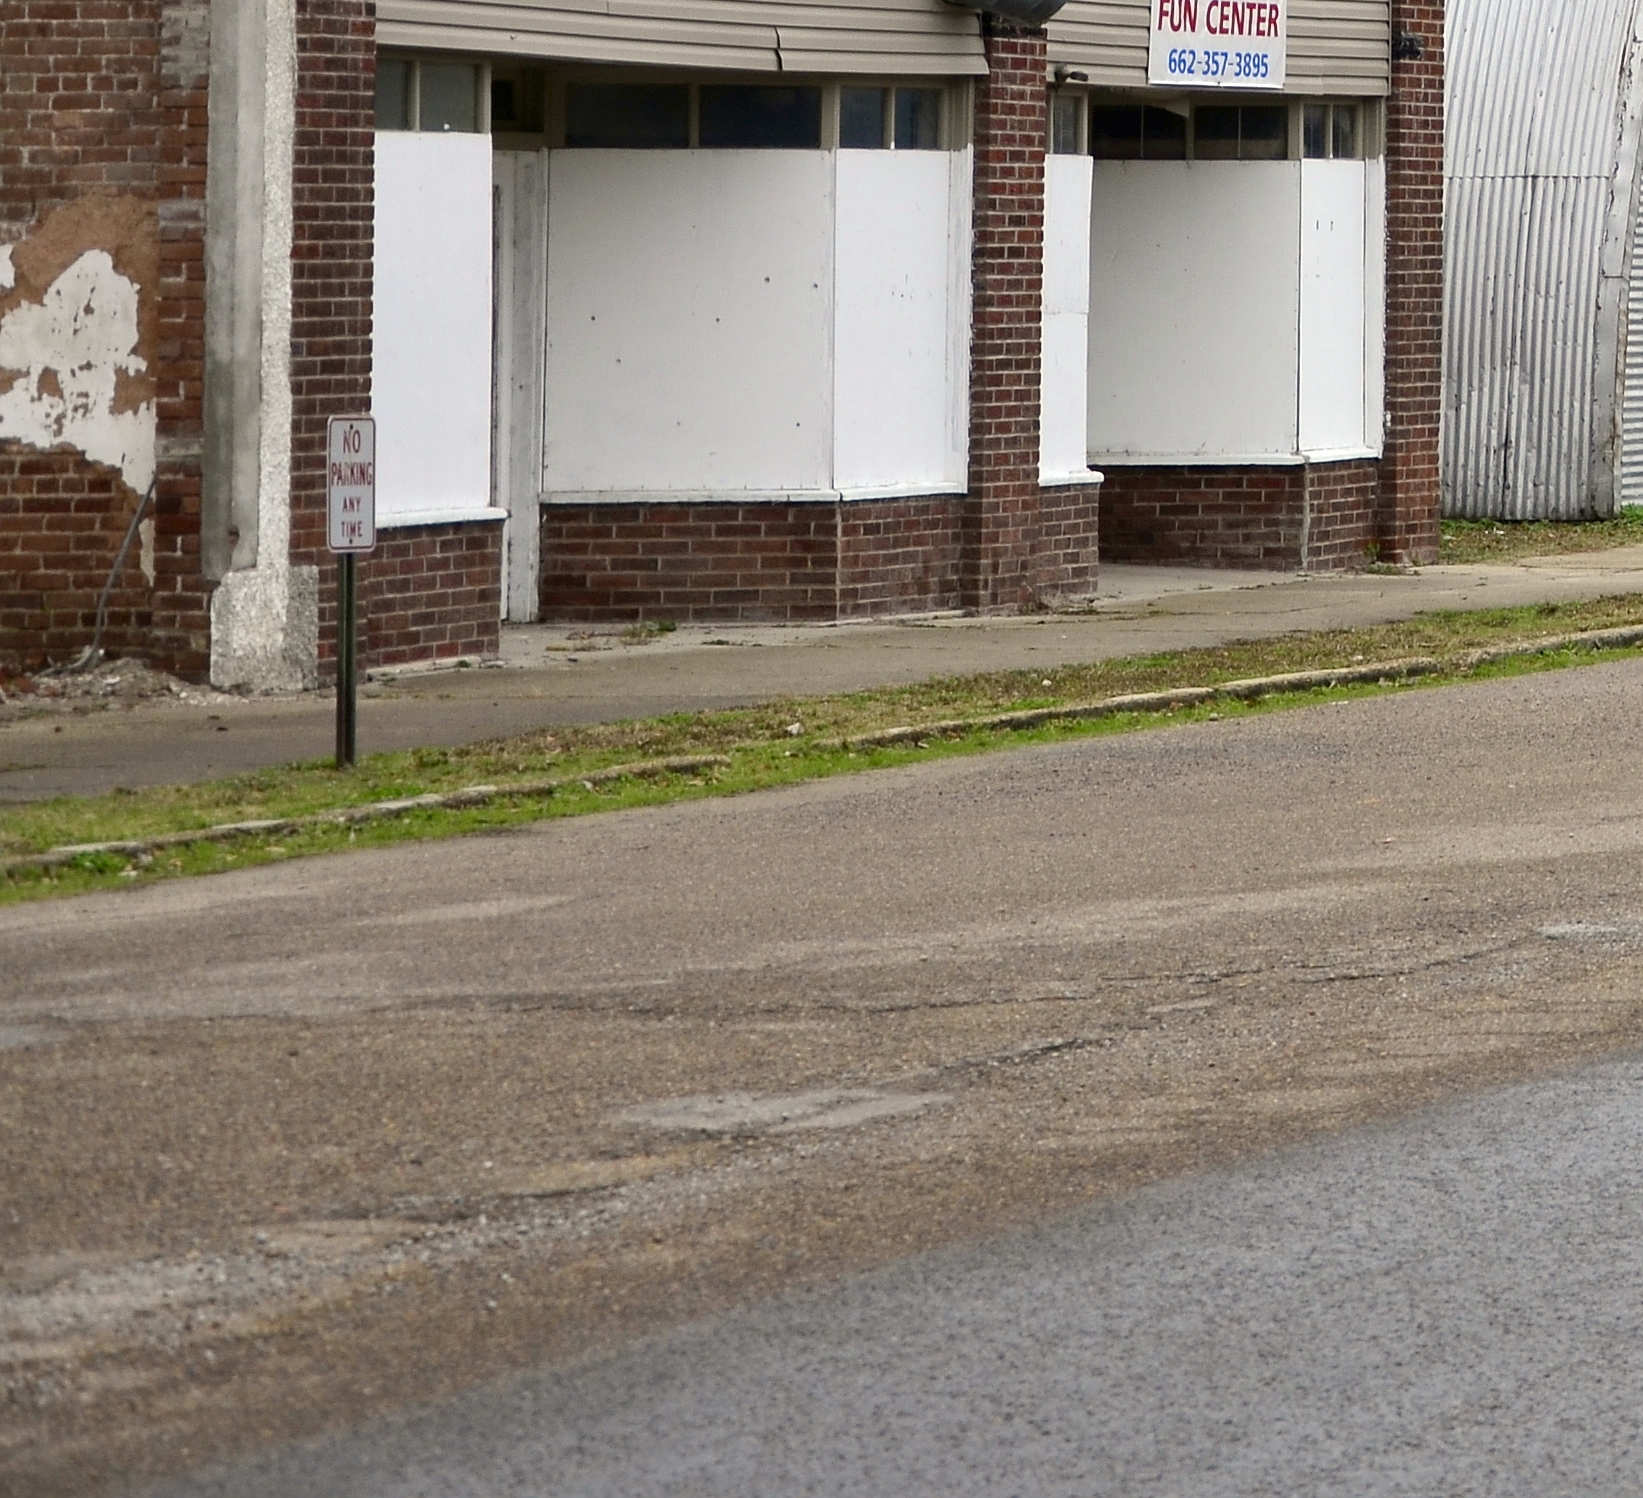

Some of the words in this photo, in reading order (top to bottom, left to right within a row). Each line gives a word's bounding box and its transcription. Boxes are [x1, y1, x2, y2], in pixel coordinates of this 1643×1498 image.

[1168, 48, 1269, 79] 662-357-3895
[343, 429, 361, 454] NO
[331, 462, 373, 487] PARKING
[342, 496, 361, 514] ANY
[341, 520, 363, 538] TIME
